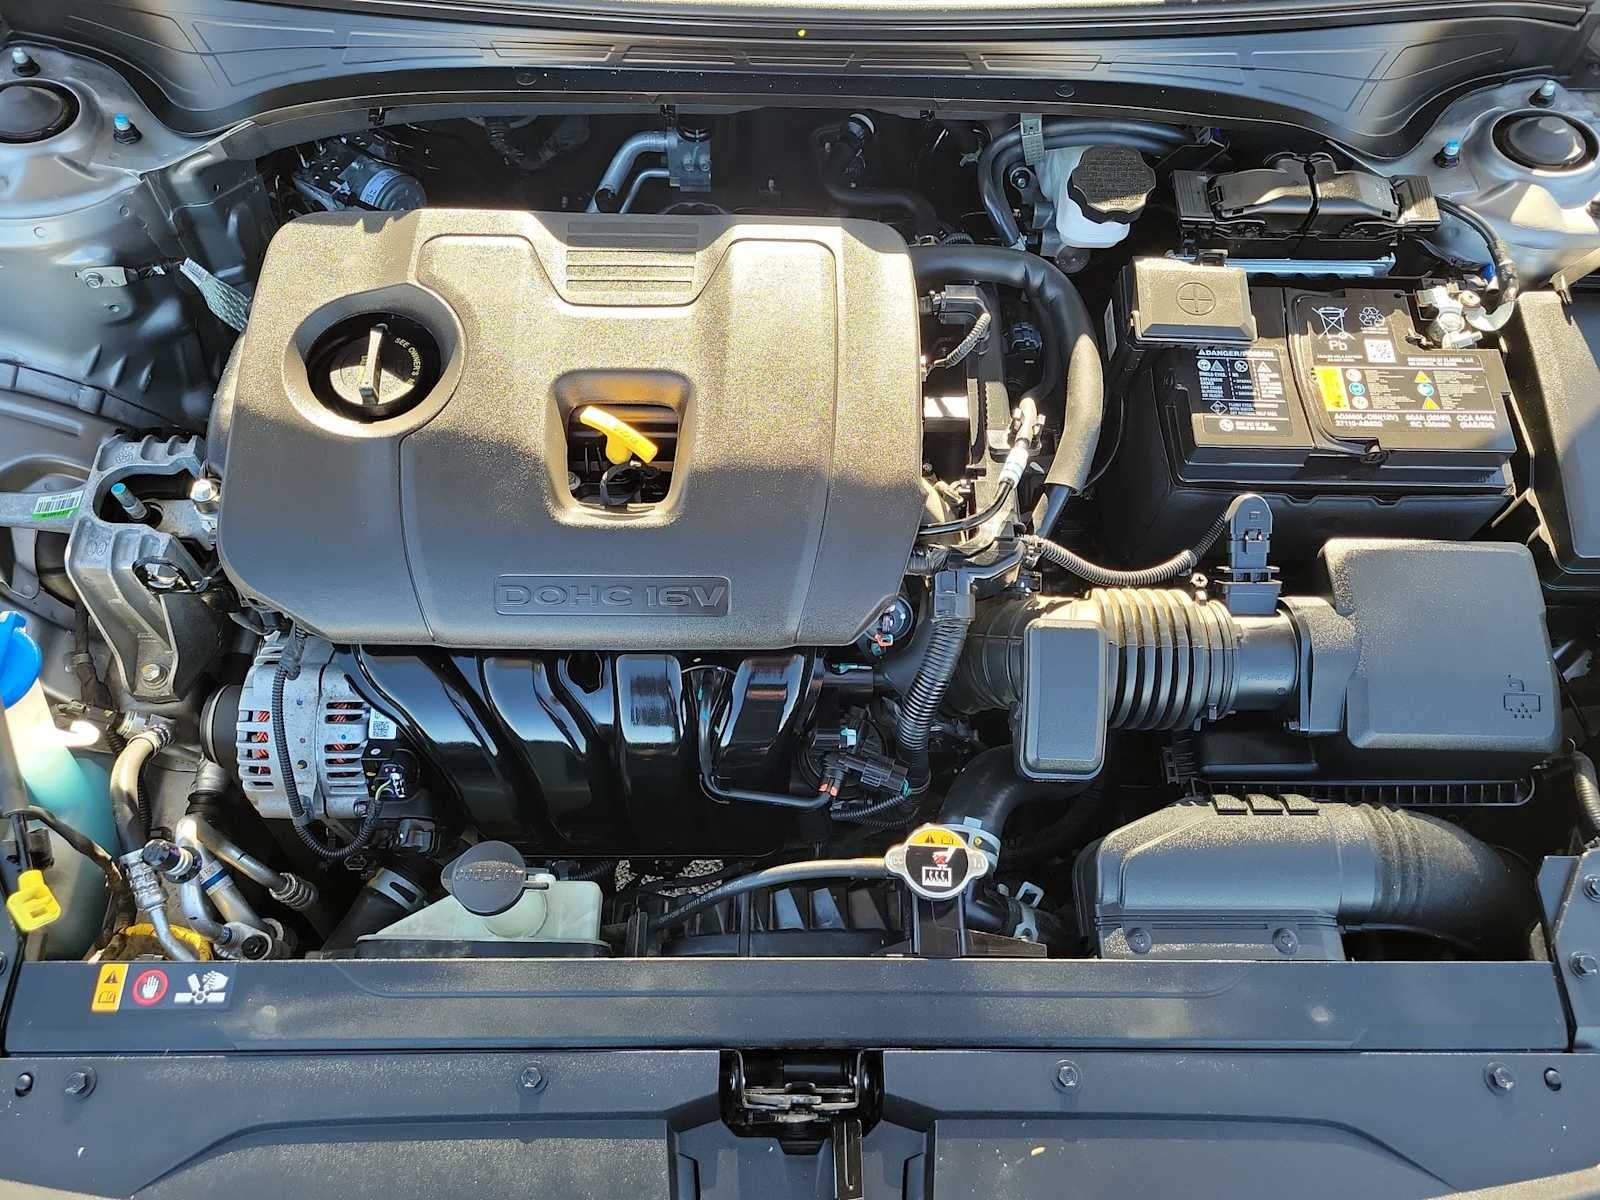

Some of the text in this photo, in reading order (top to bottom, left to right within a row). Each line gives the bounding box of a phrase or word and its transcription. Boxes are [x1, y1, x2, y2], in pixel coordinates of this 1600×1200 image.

[394, 337, 410, 348] SEE
[1328, 340, 1348, 351] Pb
[500, 584, 726, 608] DOHC 16V
